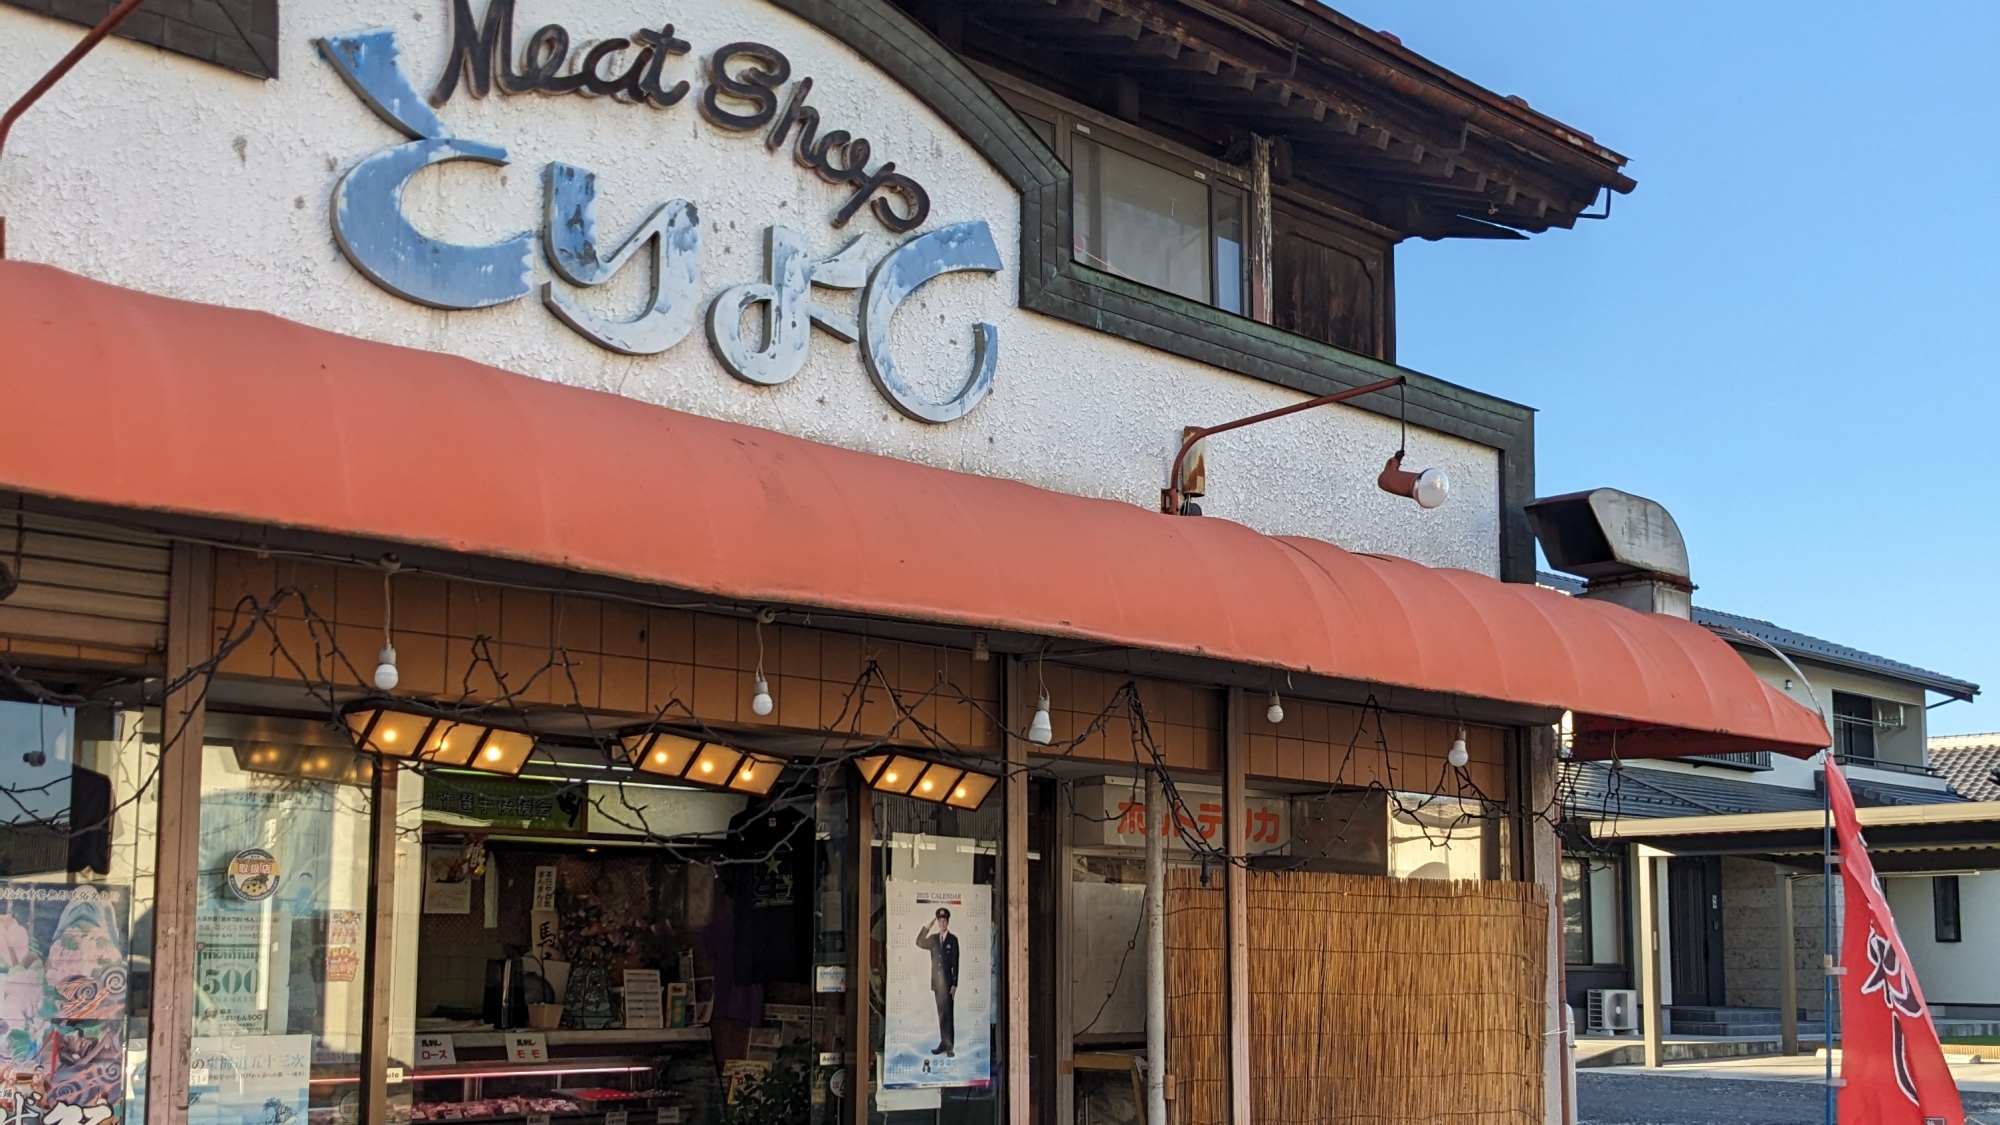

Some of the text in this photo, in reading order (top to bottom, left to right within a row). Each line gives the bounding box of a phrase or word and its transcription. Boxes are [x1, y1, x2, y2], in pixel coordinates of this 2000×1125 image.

[430, 0, 931, 233] Meat Shop
[237, 863, 273, 875] 取扱店
[930, 892, 962, 900] CALENDAR
[203, 968, 259, 995] 500
[421, 1049, 448, 1060] ロース
